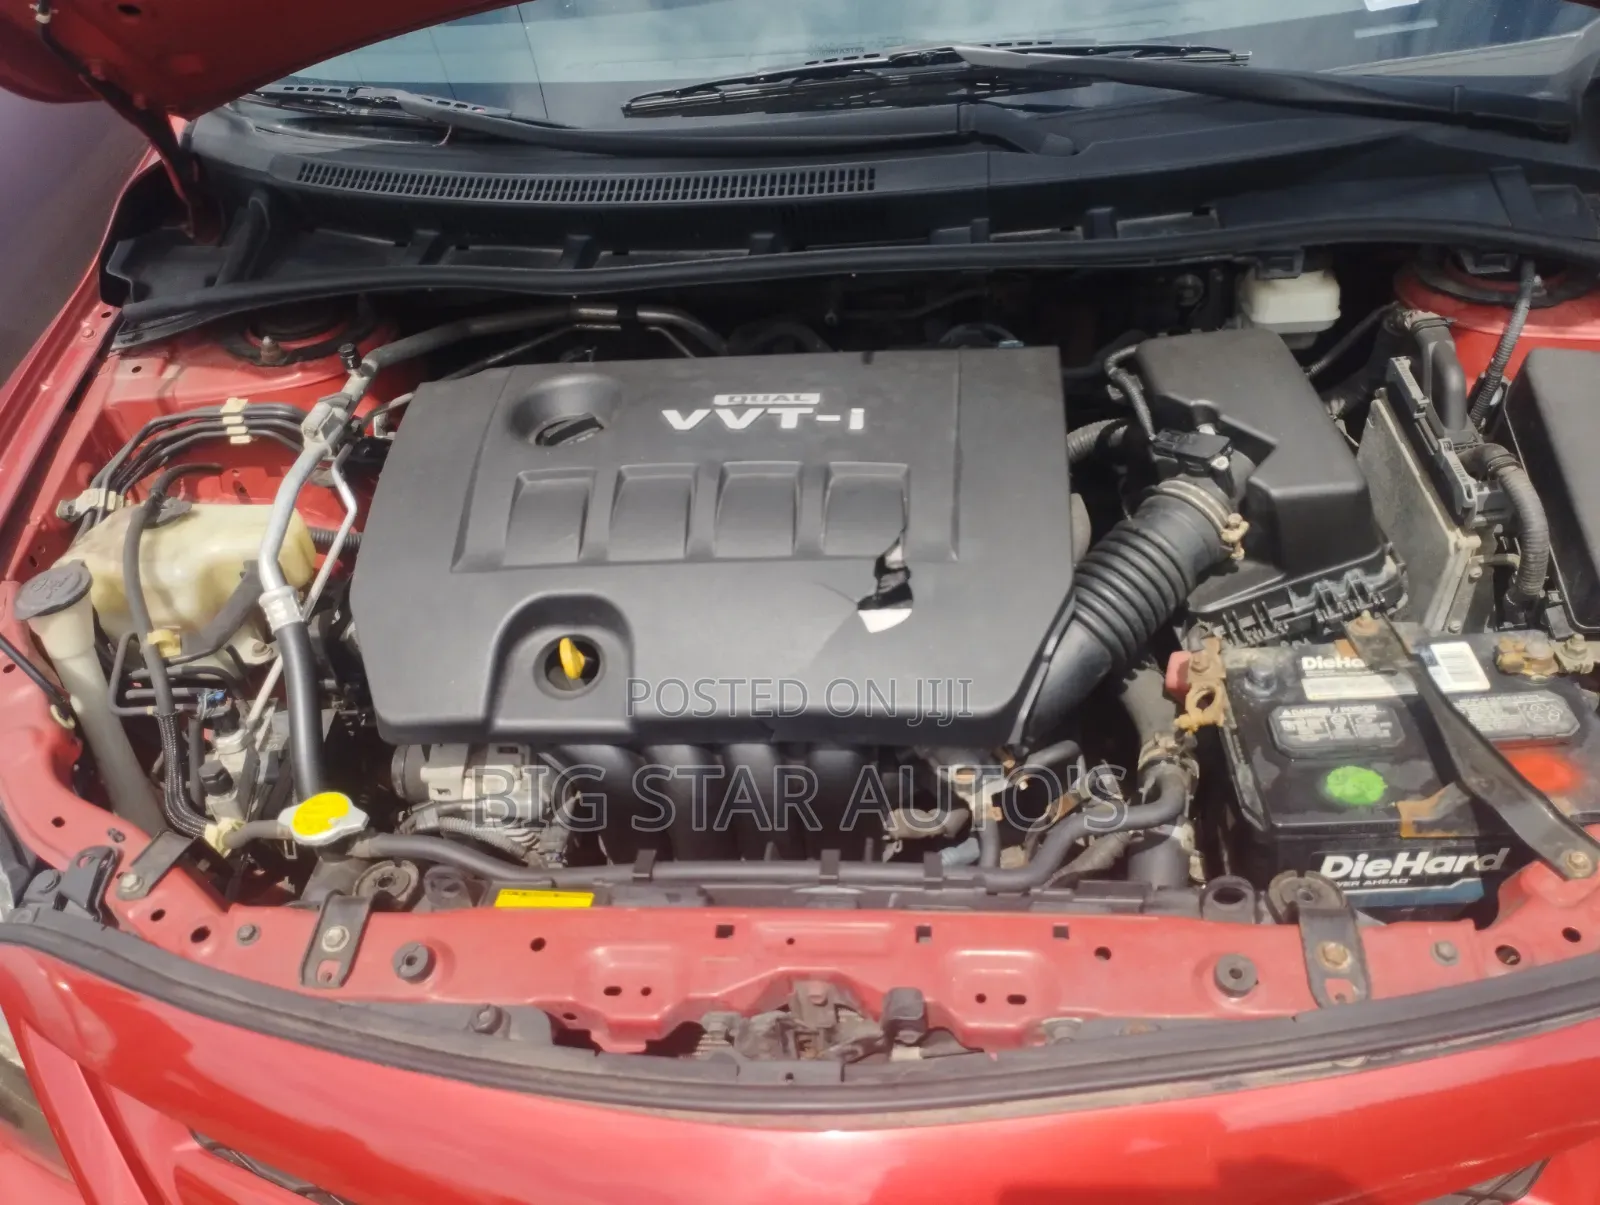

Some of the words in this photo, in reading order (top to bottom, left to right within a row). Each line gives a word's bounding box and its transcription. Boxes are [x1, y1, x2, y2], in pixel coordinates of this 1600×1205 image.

[726, 394, 814, 403] DUAL
[1301, 655, 1367, 671] DieHa
[1320, 848, 1510, 878] DieHard
[1363, 878, 1409, 886] AHEAD
